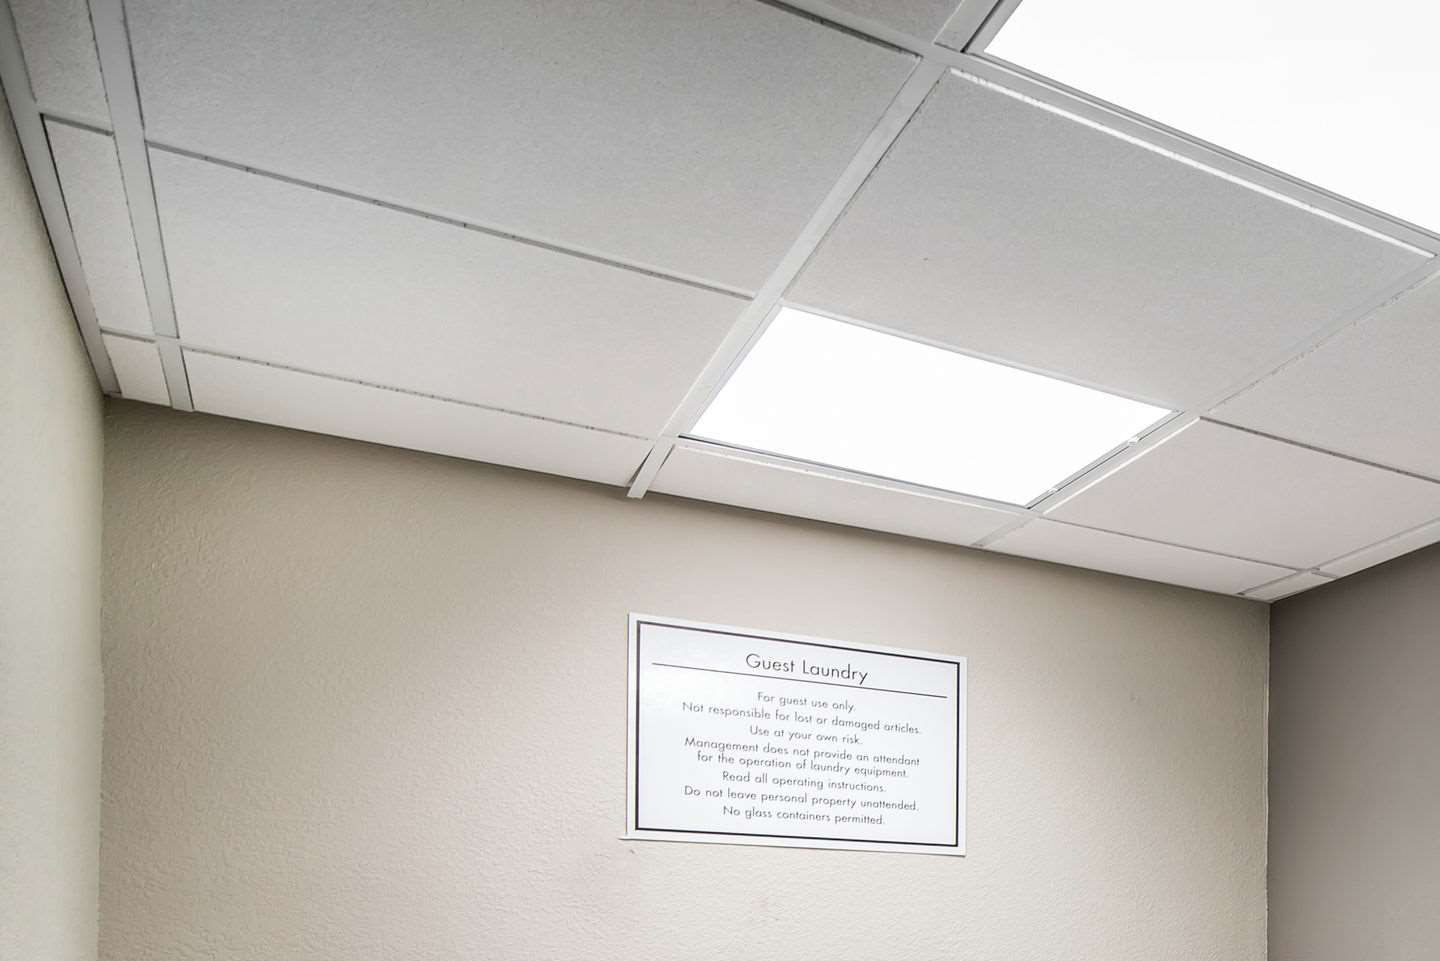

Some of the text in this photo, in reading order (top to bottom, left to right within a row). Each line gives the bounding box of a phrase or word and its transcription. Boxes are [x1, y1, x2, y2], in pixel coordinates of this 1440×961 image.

[746, 653, 868, 685] Guest Laundry
[758, 692, 856, 713] For guest use only.
[682, 702, 704, 712] Not
[708, 706, 771, 719] responsible
[776, 709, 790, 720] for
[795, 711, 812, 723] lost
[832, 716, 880, 732] damaged
[884, 722, 921, 734] articles.
[750, 724, 863, 744] Use at your own risk.
[684, 737, 758, 752] Management
[763, 742, 788, 754] does
[793, 748, 810, 756] not
[814, 748, 852, 760] provide
[873, 755, 920, 766] attendant
[697, 750, 908, 778] for the operation of laundry equipment.
[722, 770, 886, 792] Read all operating instructions.
[684, 785, 919, 811] Do not leave personal property unattended.
[723, 806, 885, 824] No glass containers permitted.
